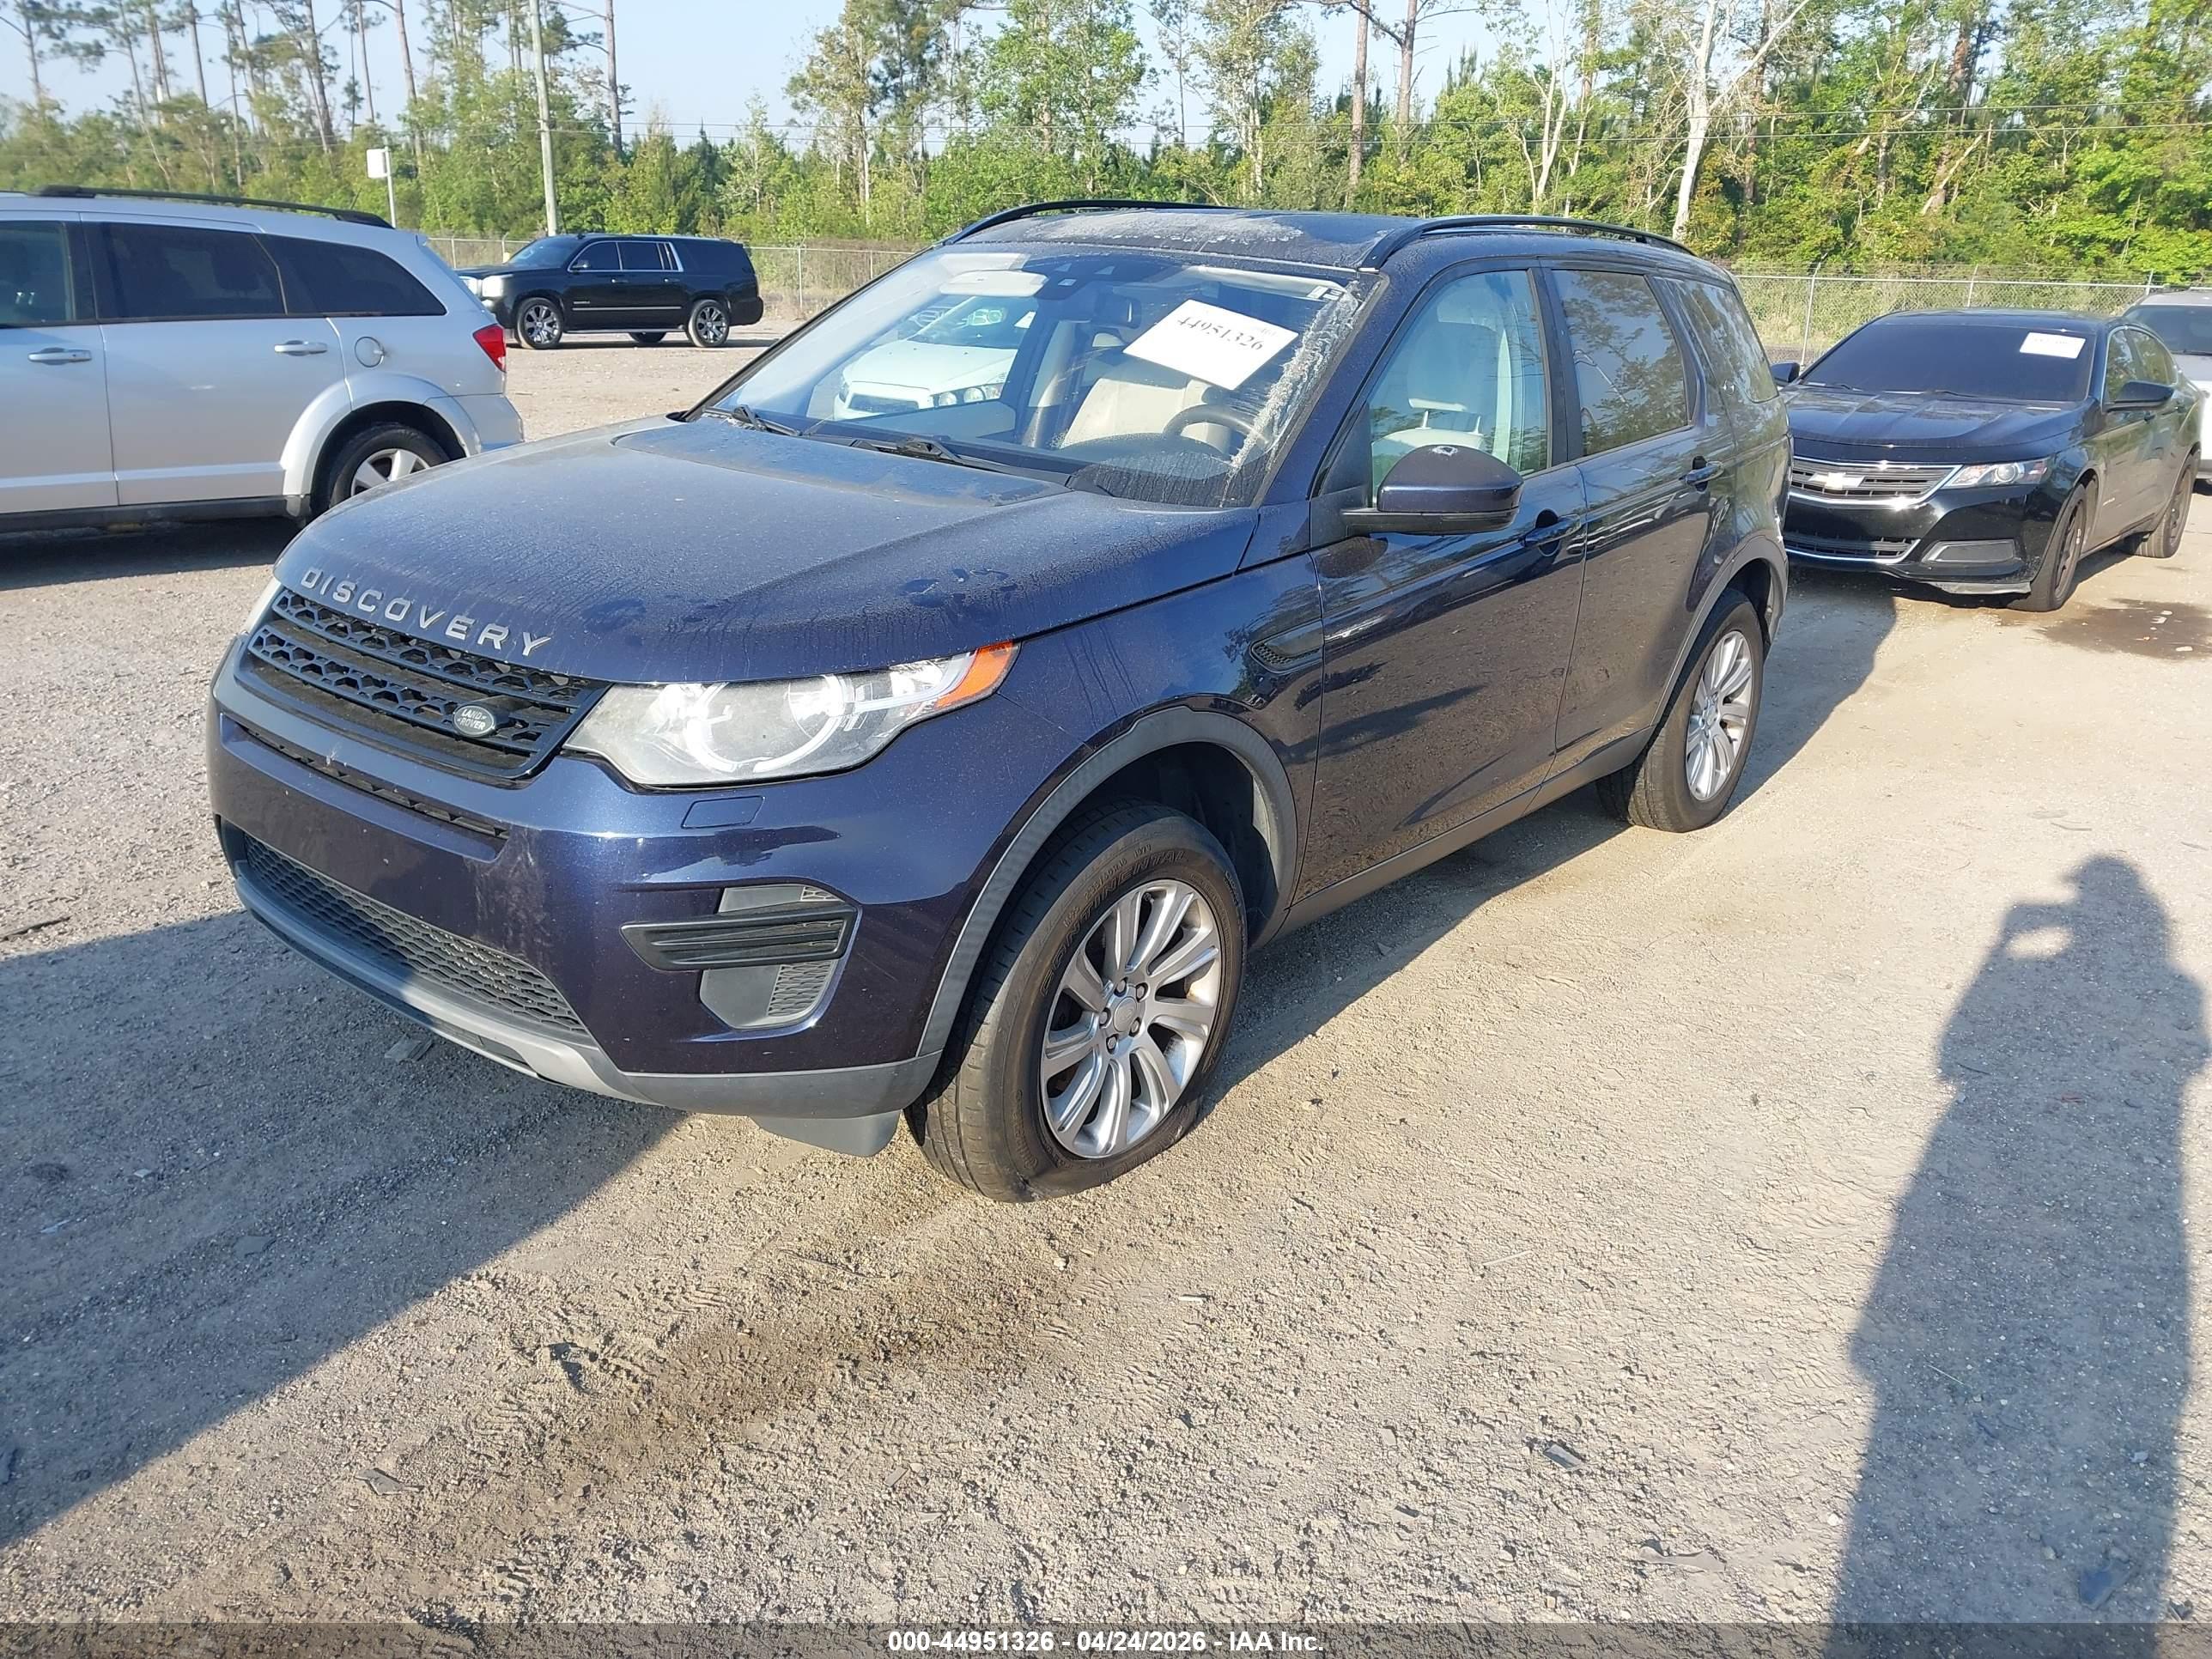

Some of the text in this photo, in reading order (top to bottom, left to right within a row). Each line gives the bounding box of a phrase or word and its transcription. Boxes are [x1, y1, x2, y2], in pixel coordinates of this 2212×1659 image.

[1177, 316, 1264, 351] 44951326
[301, 568, 551, 656] DISCOVERY
[459, 718, 486, 730] ROVER
[461, 708, 483, 720] LAND
